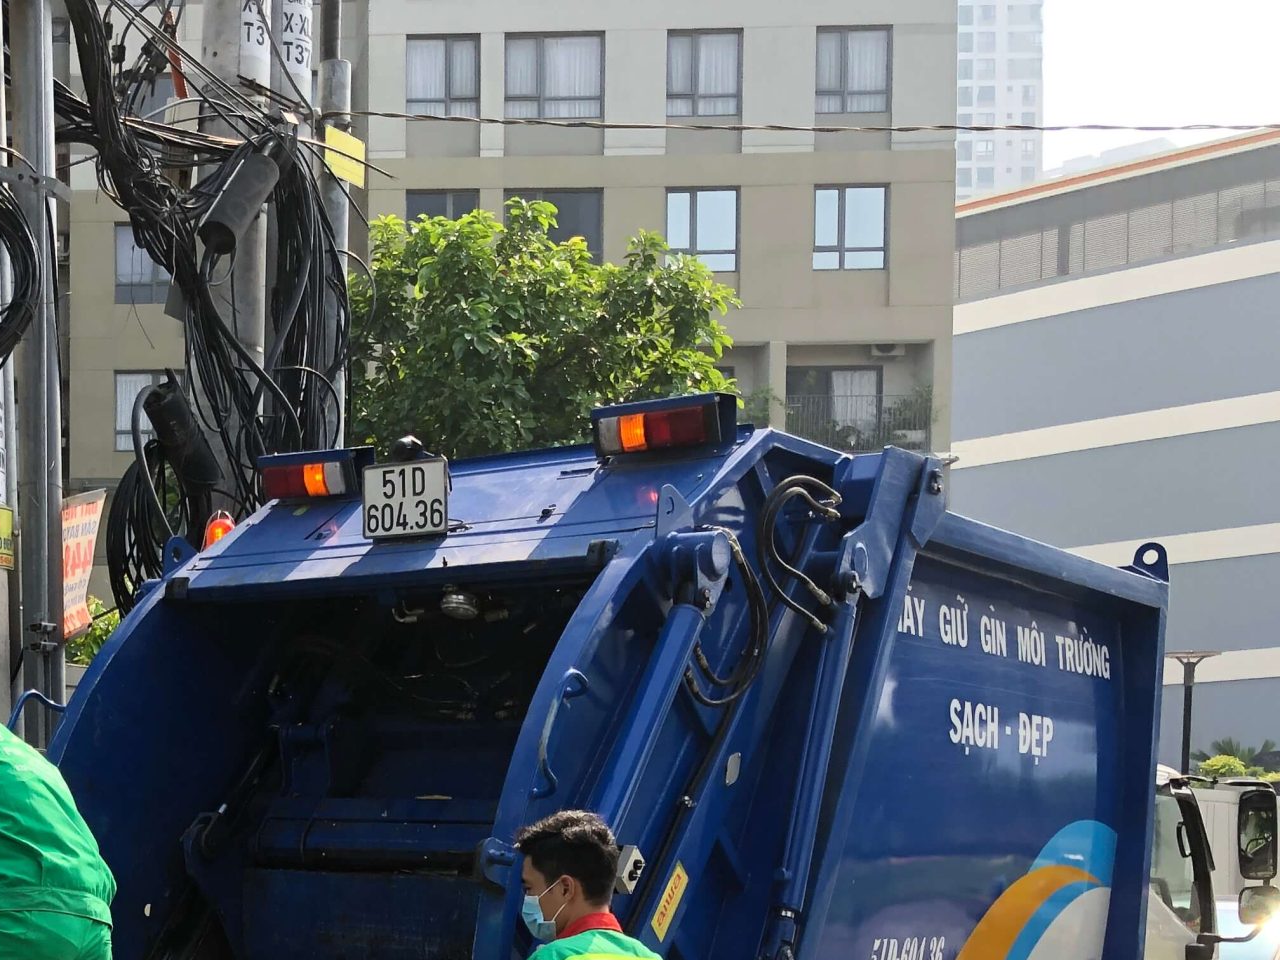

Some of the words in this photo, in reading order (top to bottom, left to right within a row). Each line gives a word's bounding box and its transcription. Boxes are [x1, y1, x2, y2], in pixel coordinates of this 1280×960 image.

[382, 467, 426, 499] 51D
[367, 499, 443, 533] 604.36
[939, 594, 969, 648] GIỮ
[980, 604, 1007, 657] GÌN
[1017, 620, 1046, 667] MÔI
[1055, 626, 1111, 680] TRƯỜNG
[949, 698, 999, 755] SẠCH
[1018, 712, 1054, 765] ĐẸP
